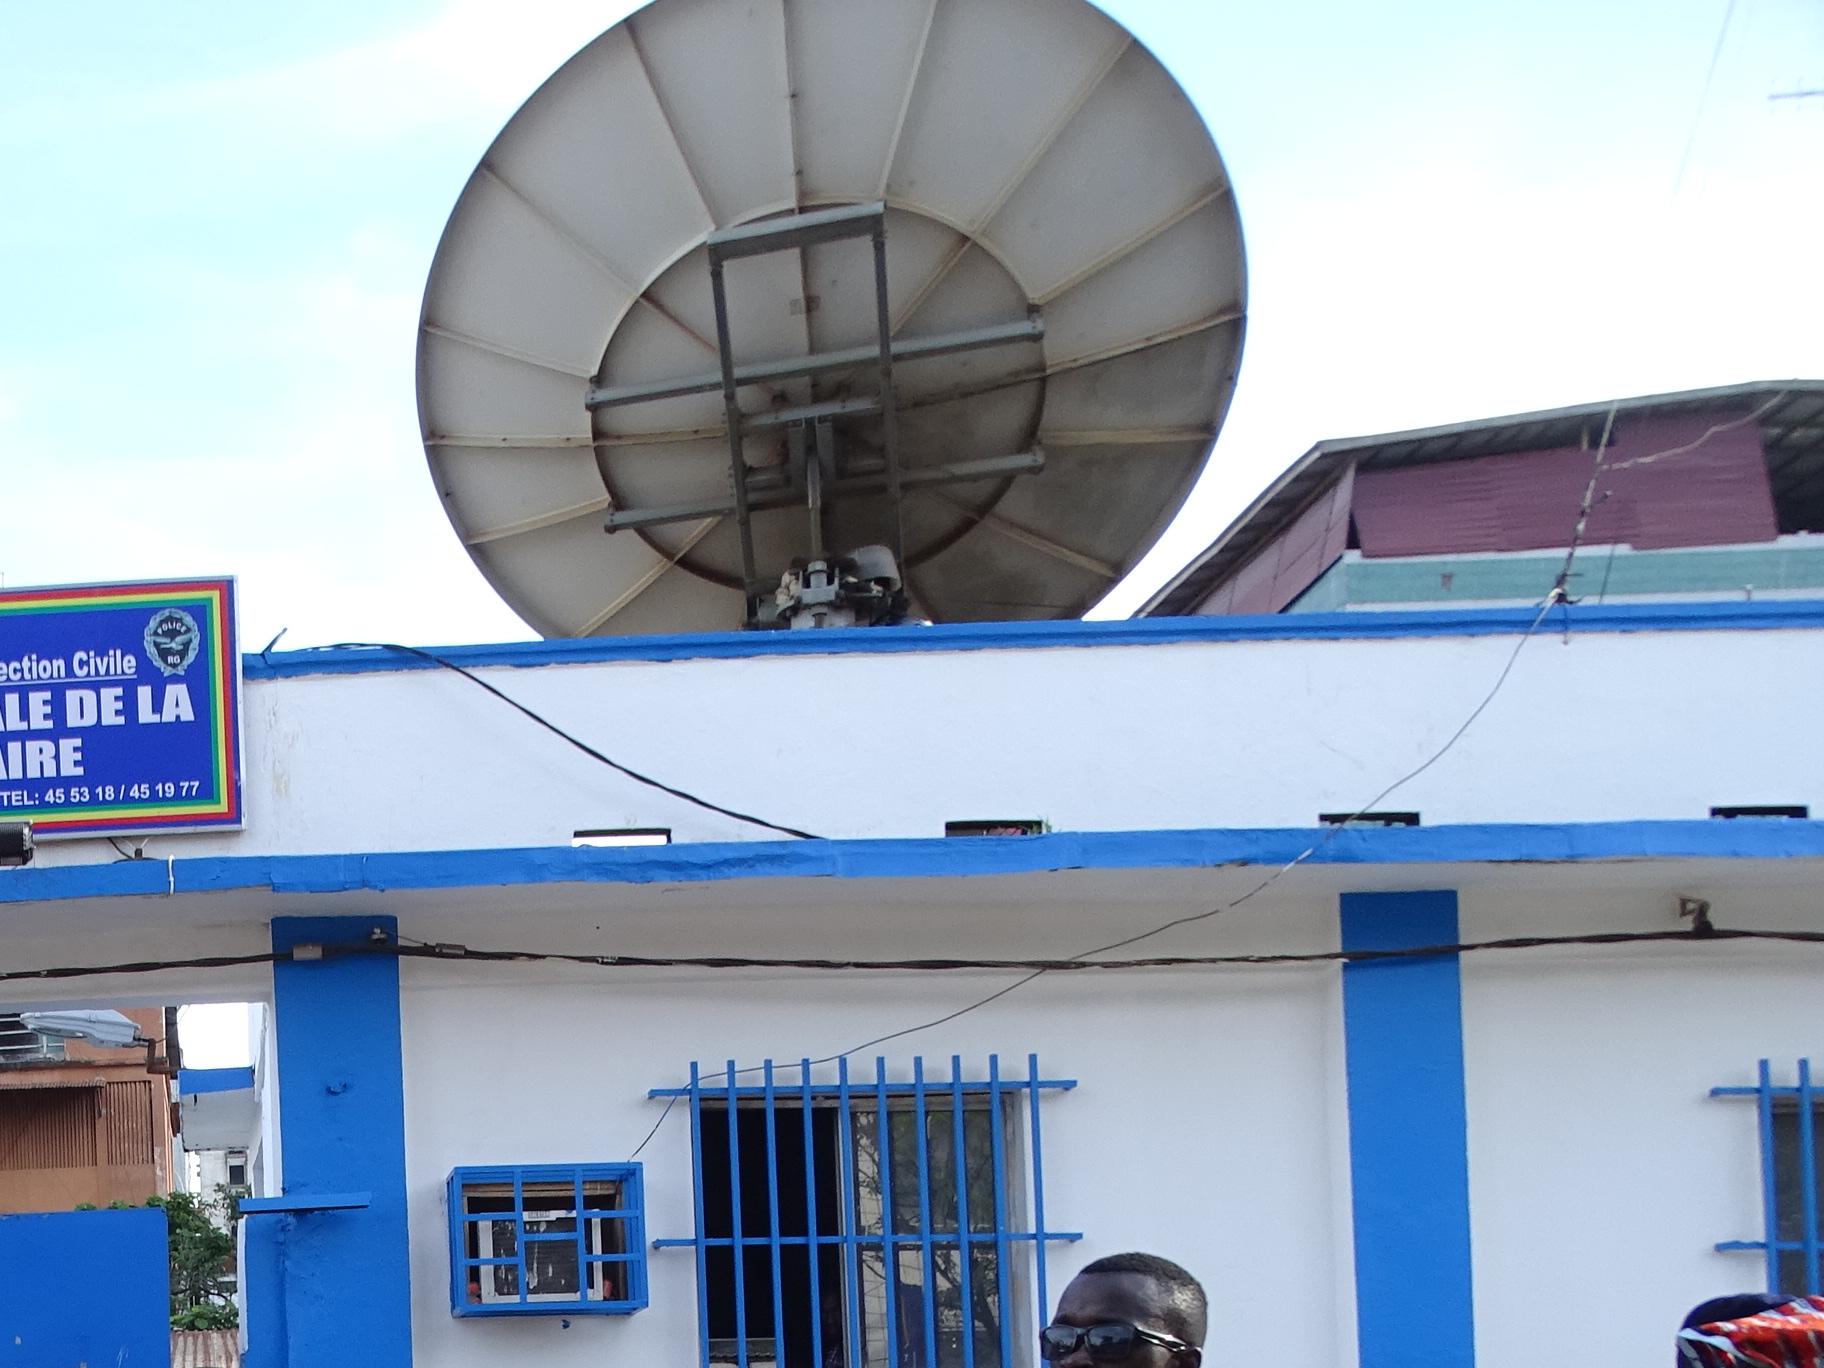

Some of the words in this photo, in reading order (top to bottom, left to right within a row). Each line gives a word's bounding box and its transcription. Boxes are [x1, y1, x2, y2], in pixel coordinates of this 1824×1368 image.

[157, 621, 188, 635] POLICE
[72, 649, 137, 677] Civile
[65, 687, 126, 728] DE
[136, 683, 195, 724] LA
[0, 789, 39, 807] TEL:
[44, 788, 65, 805] 45
[70, 786, 90, 803] 53
[95, 785, 115, 802] 18
[129, 783, 150, 800] 45
[155, 782, 175, 799] 19
[179, 781, 200, 797] 77
